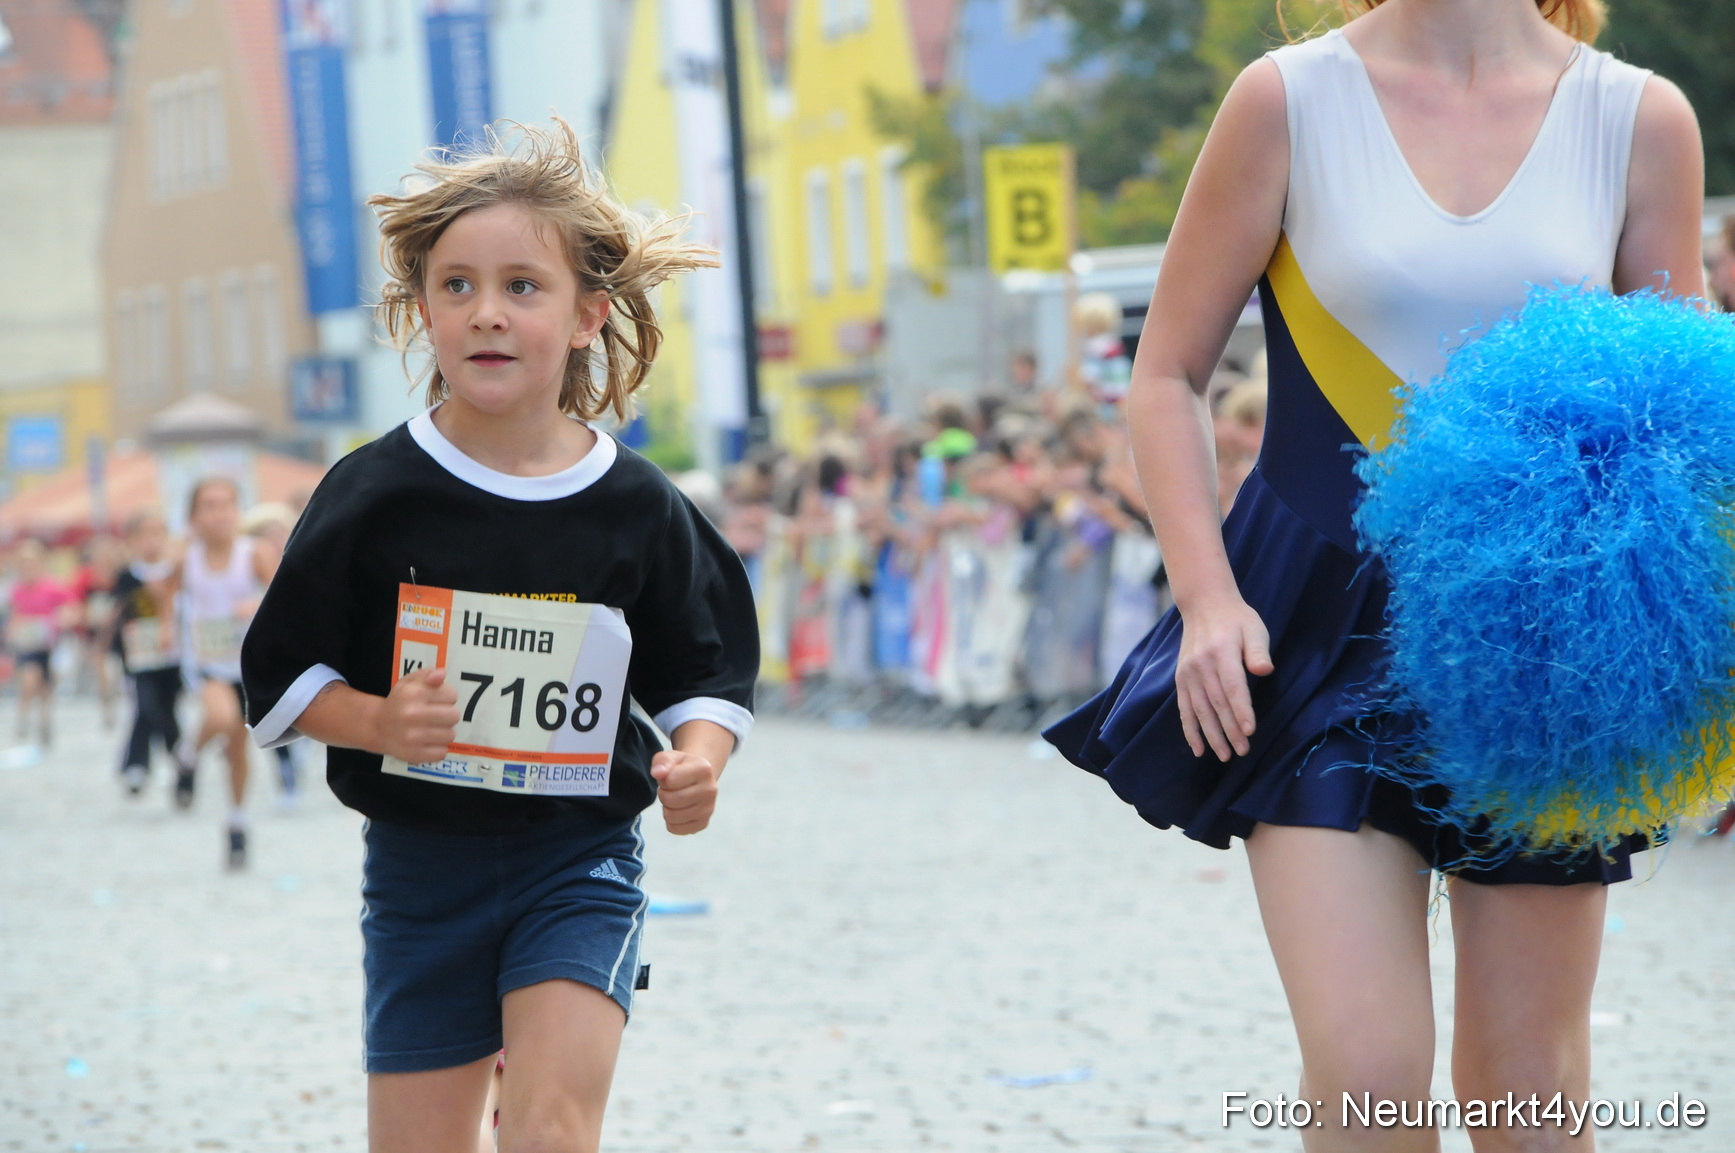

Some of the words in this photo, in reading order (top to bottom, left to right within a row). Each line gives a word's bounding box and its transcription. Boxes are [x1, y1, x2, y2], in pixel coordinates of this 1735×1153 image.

[1012, 187, 1054, 248] B
[460, 610, 554, 654] Hanna
[460, 671, 602, 732] 7168
[529, 765, 606, 781] PFLEIDERER
